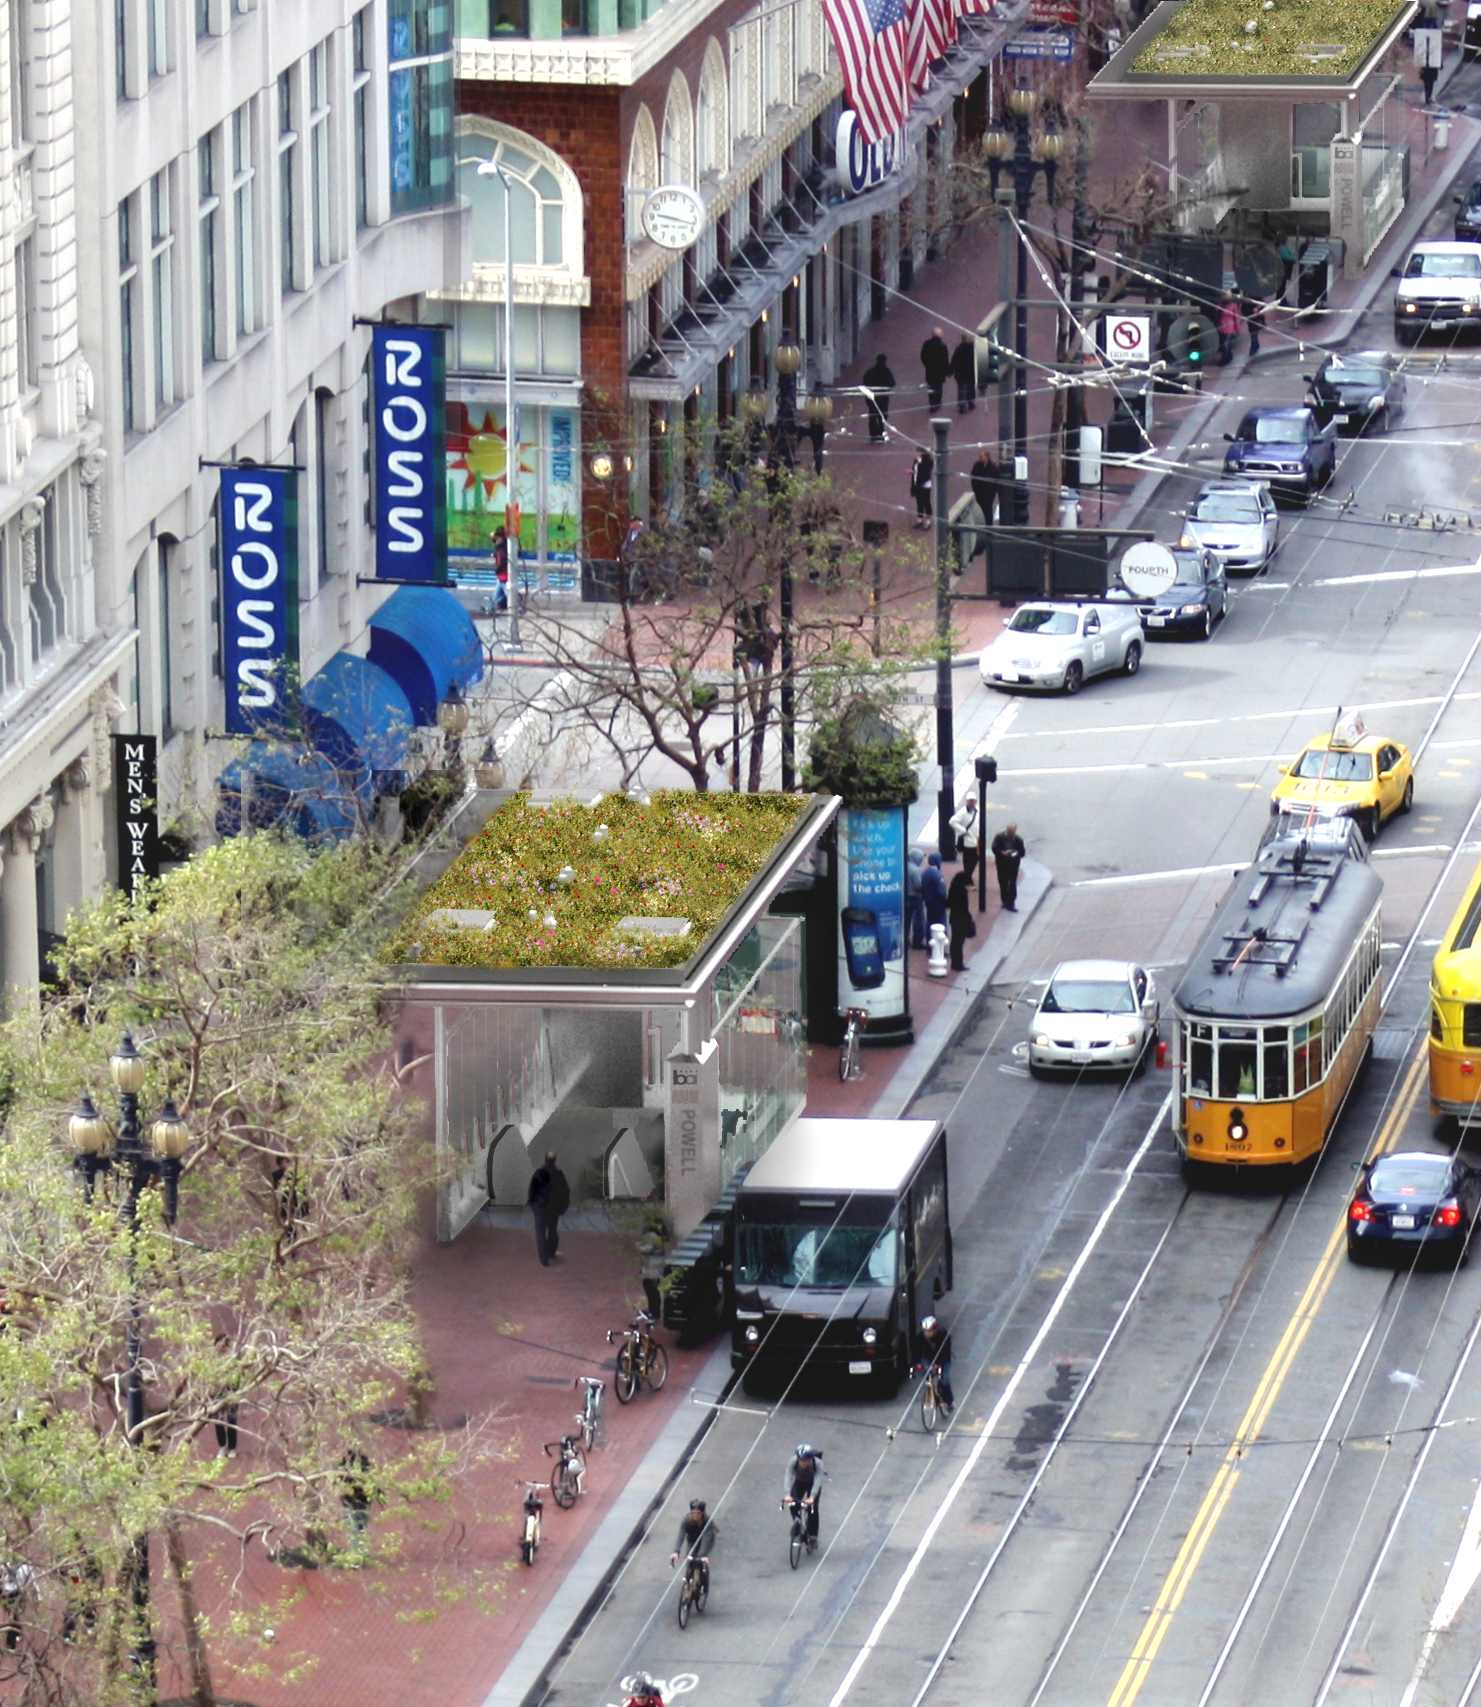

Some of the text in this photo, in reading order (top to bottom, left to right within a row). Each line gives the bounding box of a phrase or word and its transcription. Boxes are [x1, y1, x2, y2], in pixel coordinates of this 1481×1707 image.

[1341, 178, 1352, 229] POWELL
[383, 339, 426, 553] ROSS
[232, 482, 278, 707] ROSS
[1128, 565, 1169, 575] FOURTH
[125, 743, 147, 815] MEN'S
[853, 871, 891, 881] pick up
[876, 846, 896, 856] your
[853, 884, 871, 893] the
[681, 1109, 696, 1176] POWELL
